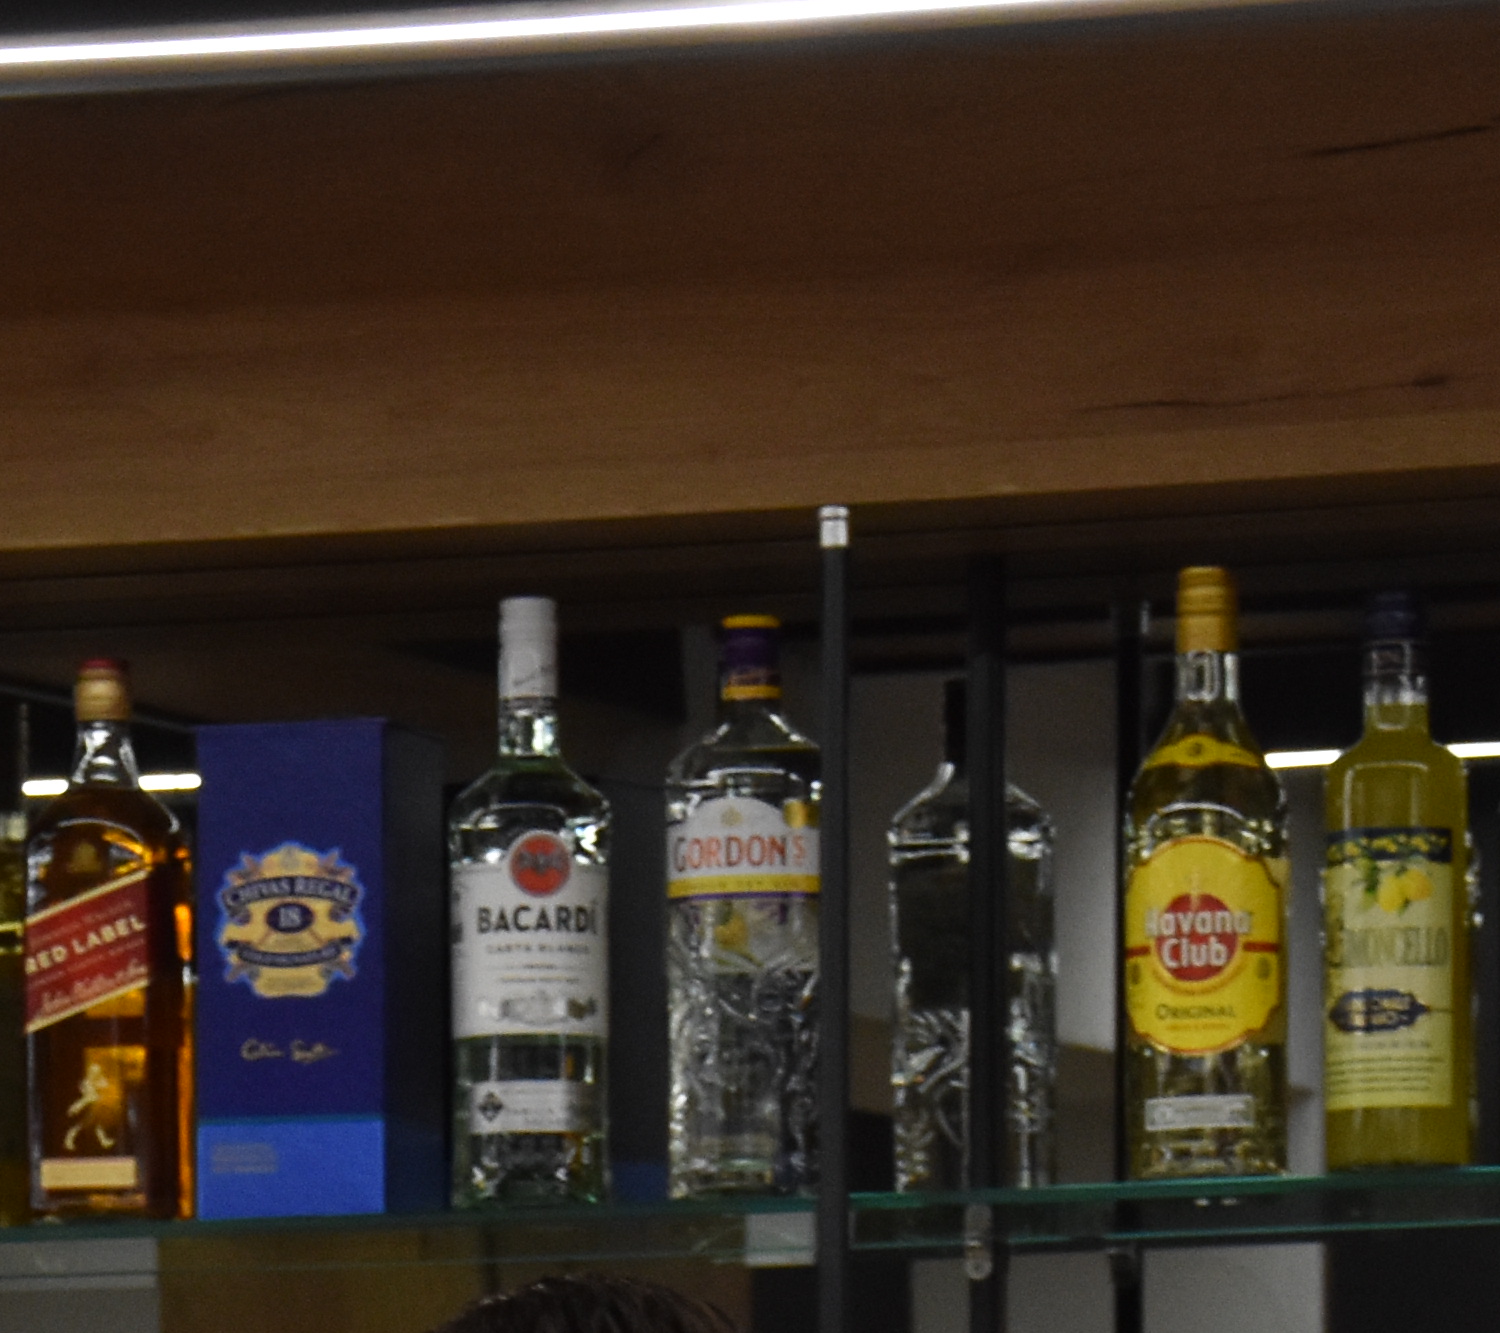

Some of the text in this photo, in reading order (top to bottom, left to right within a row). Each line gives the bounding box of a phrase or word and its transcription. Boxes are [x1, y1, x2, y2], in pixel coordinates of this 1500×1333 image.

[1145, 906, 1252, 937] Havana
[25, 945, 68, 975] RED
[72, 915, 147, 956] LABEL
[1160, 936, 1228, 968] Club
